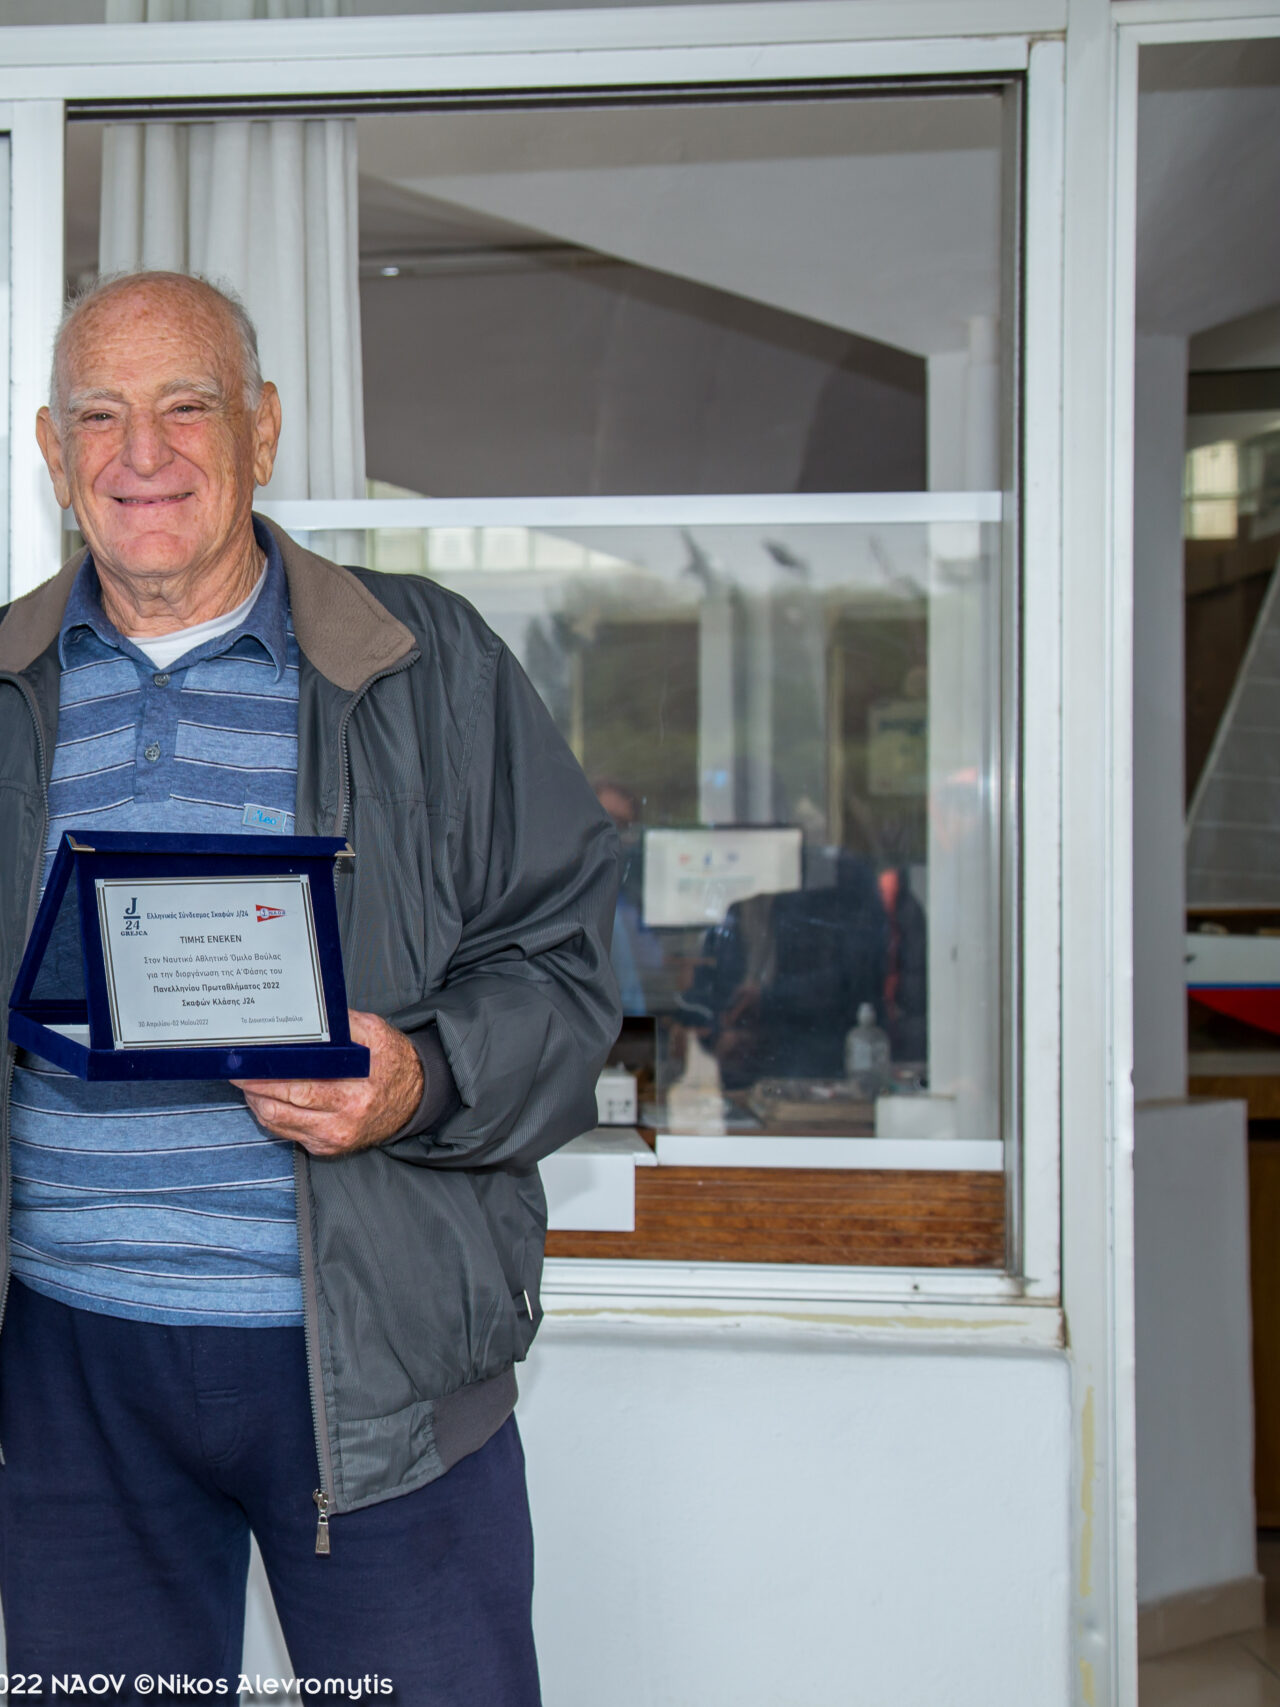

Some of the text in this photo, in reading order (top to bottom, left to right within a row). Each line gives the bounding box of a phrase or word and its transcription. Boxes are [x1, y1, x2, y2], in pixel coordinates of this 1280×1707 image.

[125, 897, 138, 915] J
[125, 920, 140, 930] 24
[180, 934, 242, 944] ΤΙΜΗΣ ΕΝΕΚΕΝ
[144, 956, 161, 964] Στον
[162, 954, 193, 963] Ναυτικό
[195, 954, 229, 963] Αθλητικό
[254, 952, 282, 961] Βούλας
[146, 972, 158, 980] για
[160, 971, 173, 979] την
[153, 981, 280, 993] Πανελληνίου Πρωταθλήματος 2022
[182, 998, 211, 1007] Σκαφών
[212, 996, 241, 1006] Κλάσης
